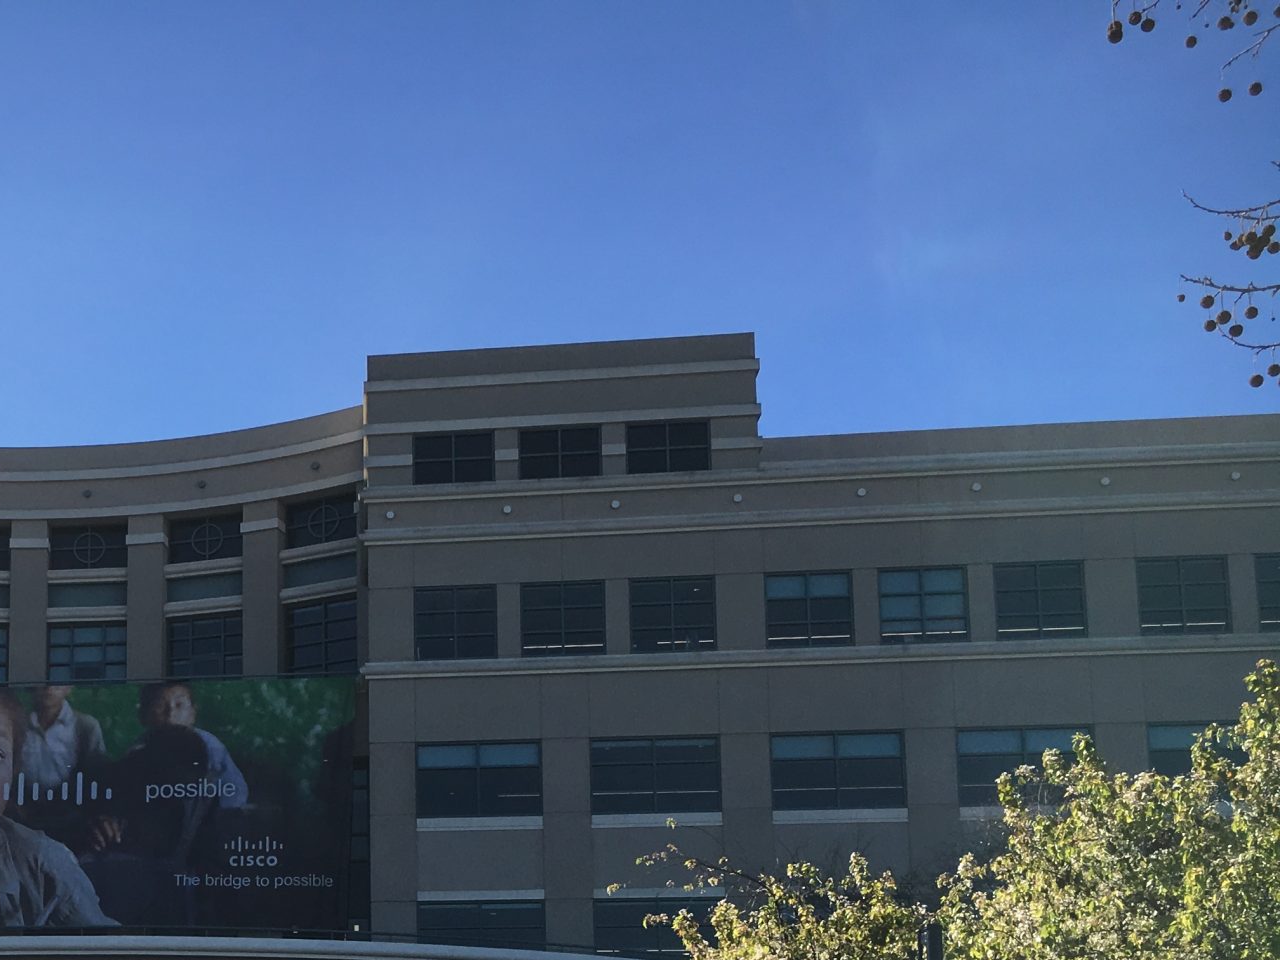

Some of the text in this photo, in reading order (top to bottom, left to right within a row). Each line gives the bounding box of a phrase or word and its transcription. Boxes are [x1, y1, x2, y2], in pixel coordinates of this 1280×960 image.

[146, 778, 236, 803] possible
[174, 874, 334, 889] The bridge to possible
